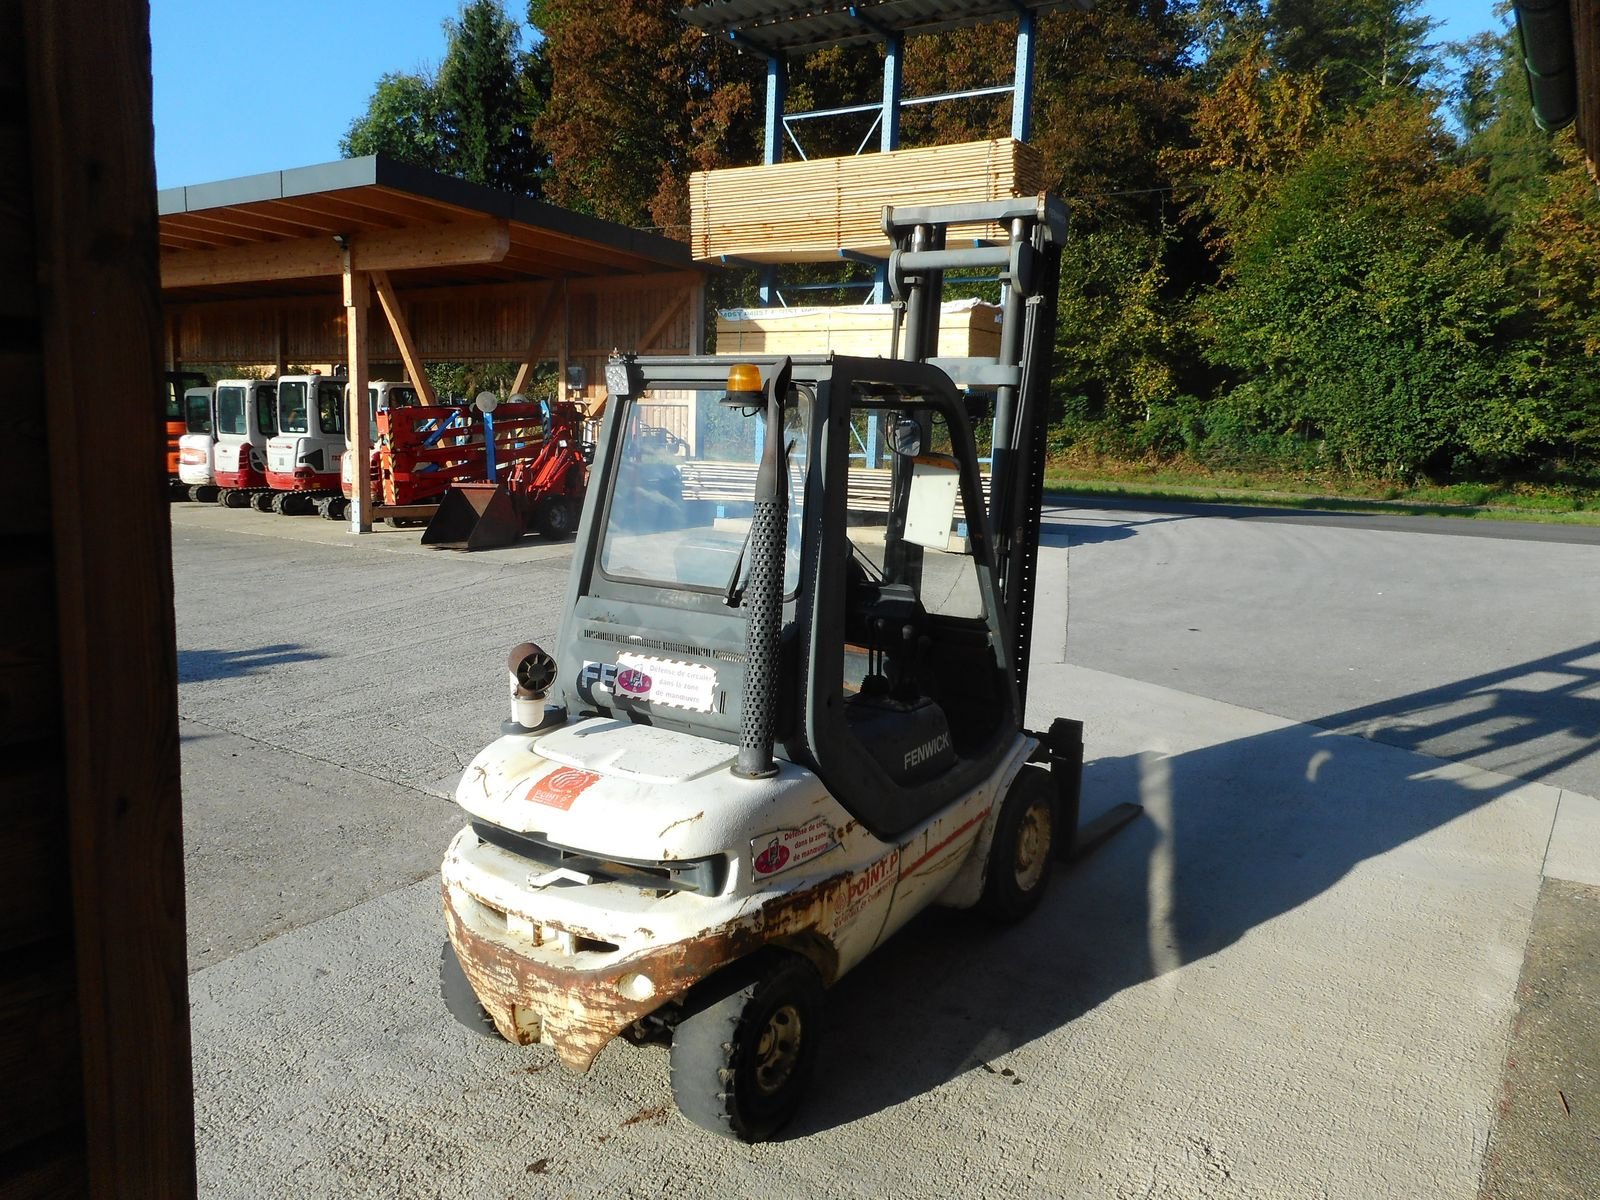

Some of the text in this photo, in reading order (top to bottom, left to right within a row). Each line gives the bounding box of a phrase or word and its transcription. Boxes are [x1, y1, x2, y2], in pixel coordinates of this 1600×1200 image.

[659, 678, 674, 687] dans
[684, 683, 699, 691] zone
[655, 689, 664, 697] de
[904, 731, 950, 771] FENWICK
[785, 827, 808, 841] Défense
[808, 823, 816, 832] de
[795, 831, 827, 849] dans la zone
[793, 853, 800, 862] de
